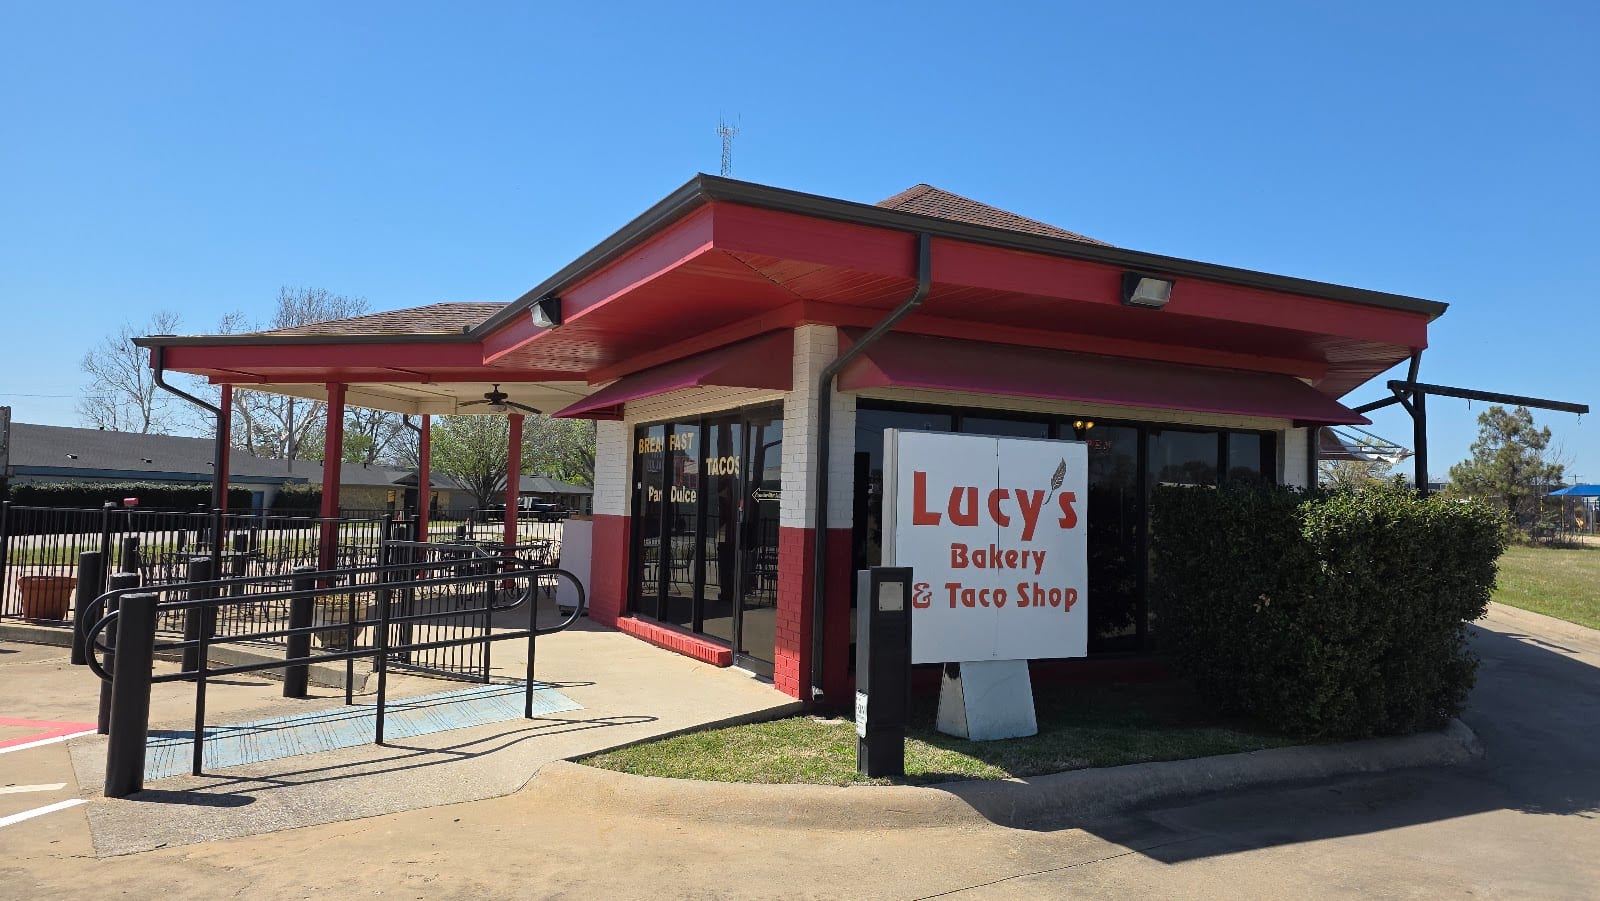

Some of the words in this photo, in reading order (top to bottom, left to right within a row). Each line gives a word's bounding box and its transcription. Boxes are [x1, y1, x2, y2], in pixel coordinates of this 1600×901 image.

[706, 455, 740, 479] TACOS
[670, 485, 697, 503] Dulce
[912, 471, 1078, 541] Lucy's
[950, 543, 1047, 575] Bakery
[912, 582, 932, 609] &
[945, 581, 1008, 609] Taco
[1016, 582, 1078, 612] Shop
